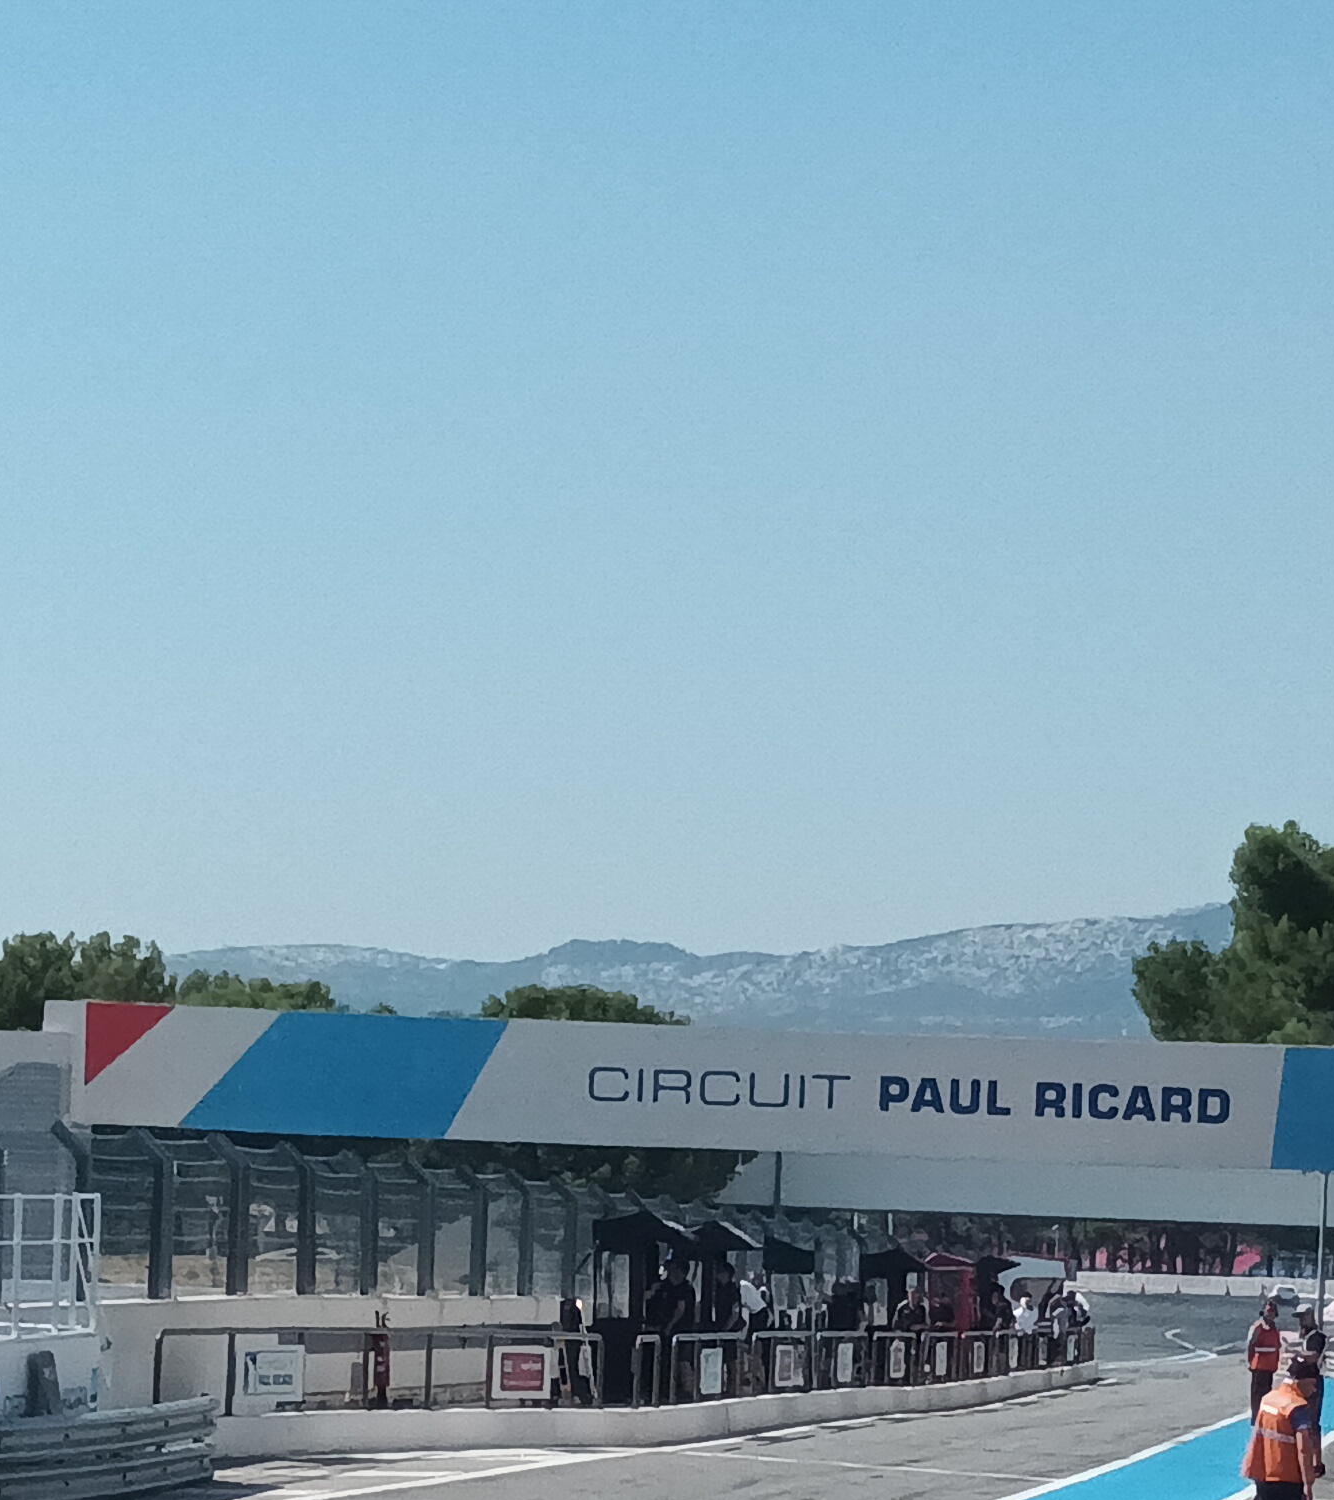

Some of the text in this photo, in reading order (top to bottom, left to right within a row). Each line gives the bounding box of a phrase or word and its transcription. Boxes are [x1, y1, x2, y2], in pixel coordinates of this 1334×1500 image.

[588, 1066, 1231, 1125] CIRCUIT PAUL RICARD
